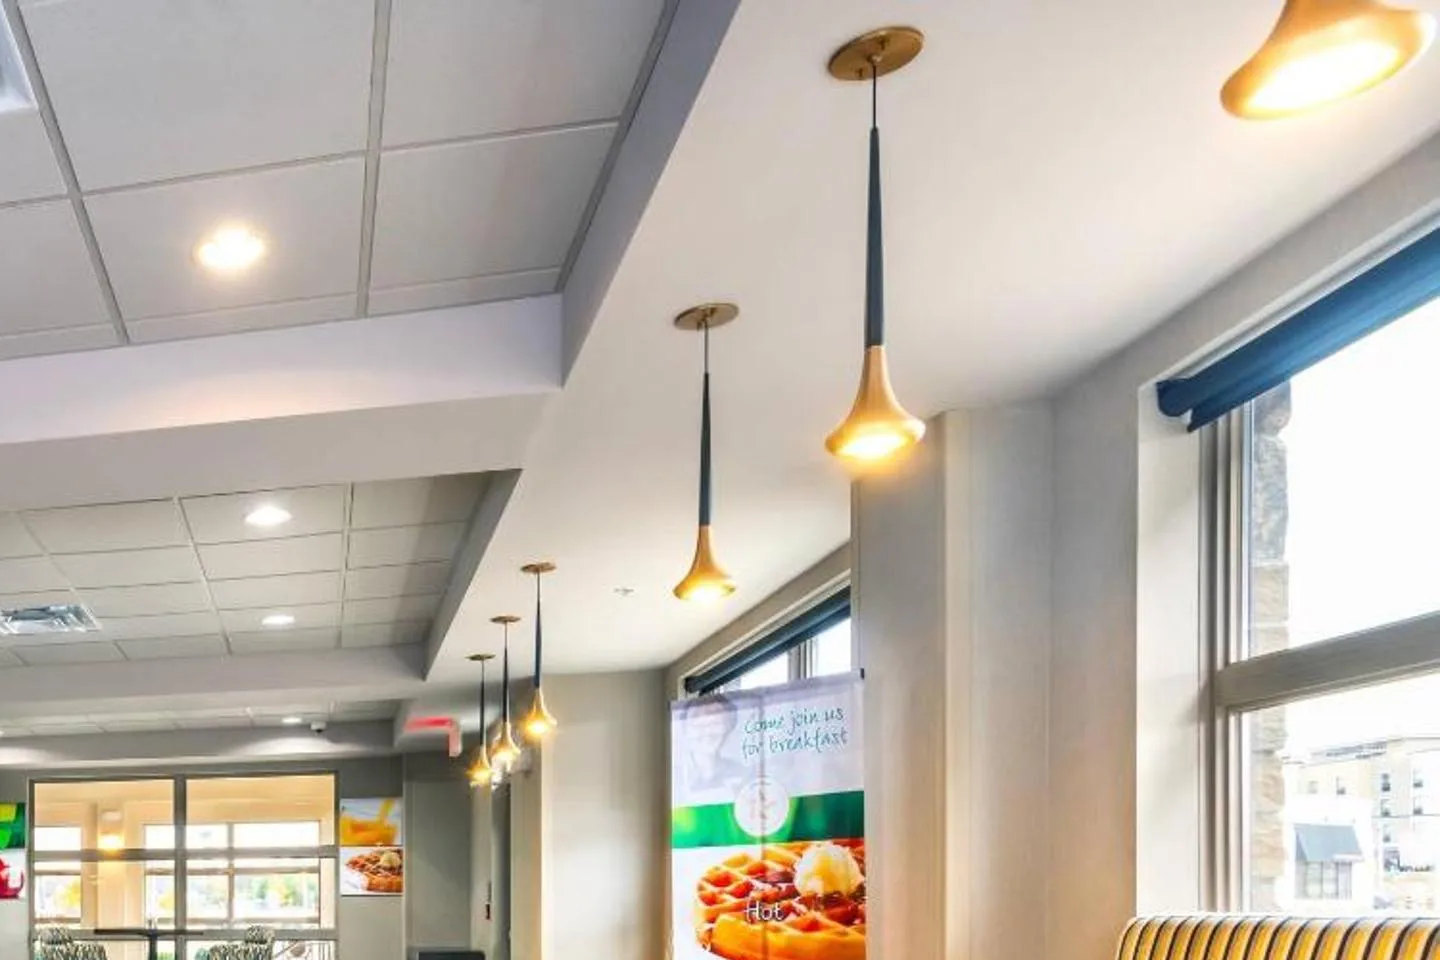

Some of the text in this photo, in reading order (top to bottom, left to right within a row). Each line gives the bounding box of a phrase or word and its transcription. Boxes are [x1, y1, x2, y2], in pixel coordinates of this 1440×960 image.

[786, 708, 817, 736] join
[824, 707, 844, 721] us
[742, 726, 849, 759] for breakfast
[743, 897, 785, 922] Hot
